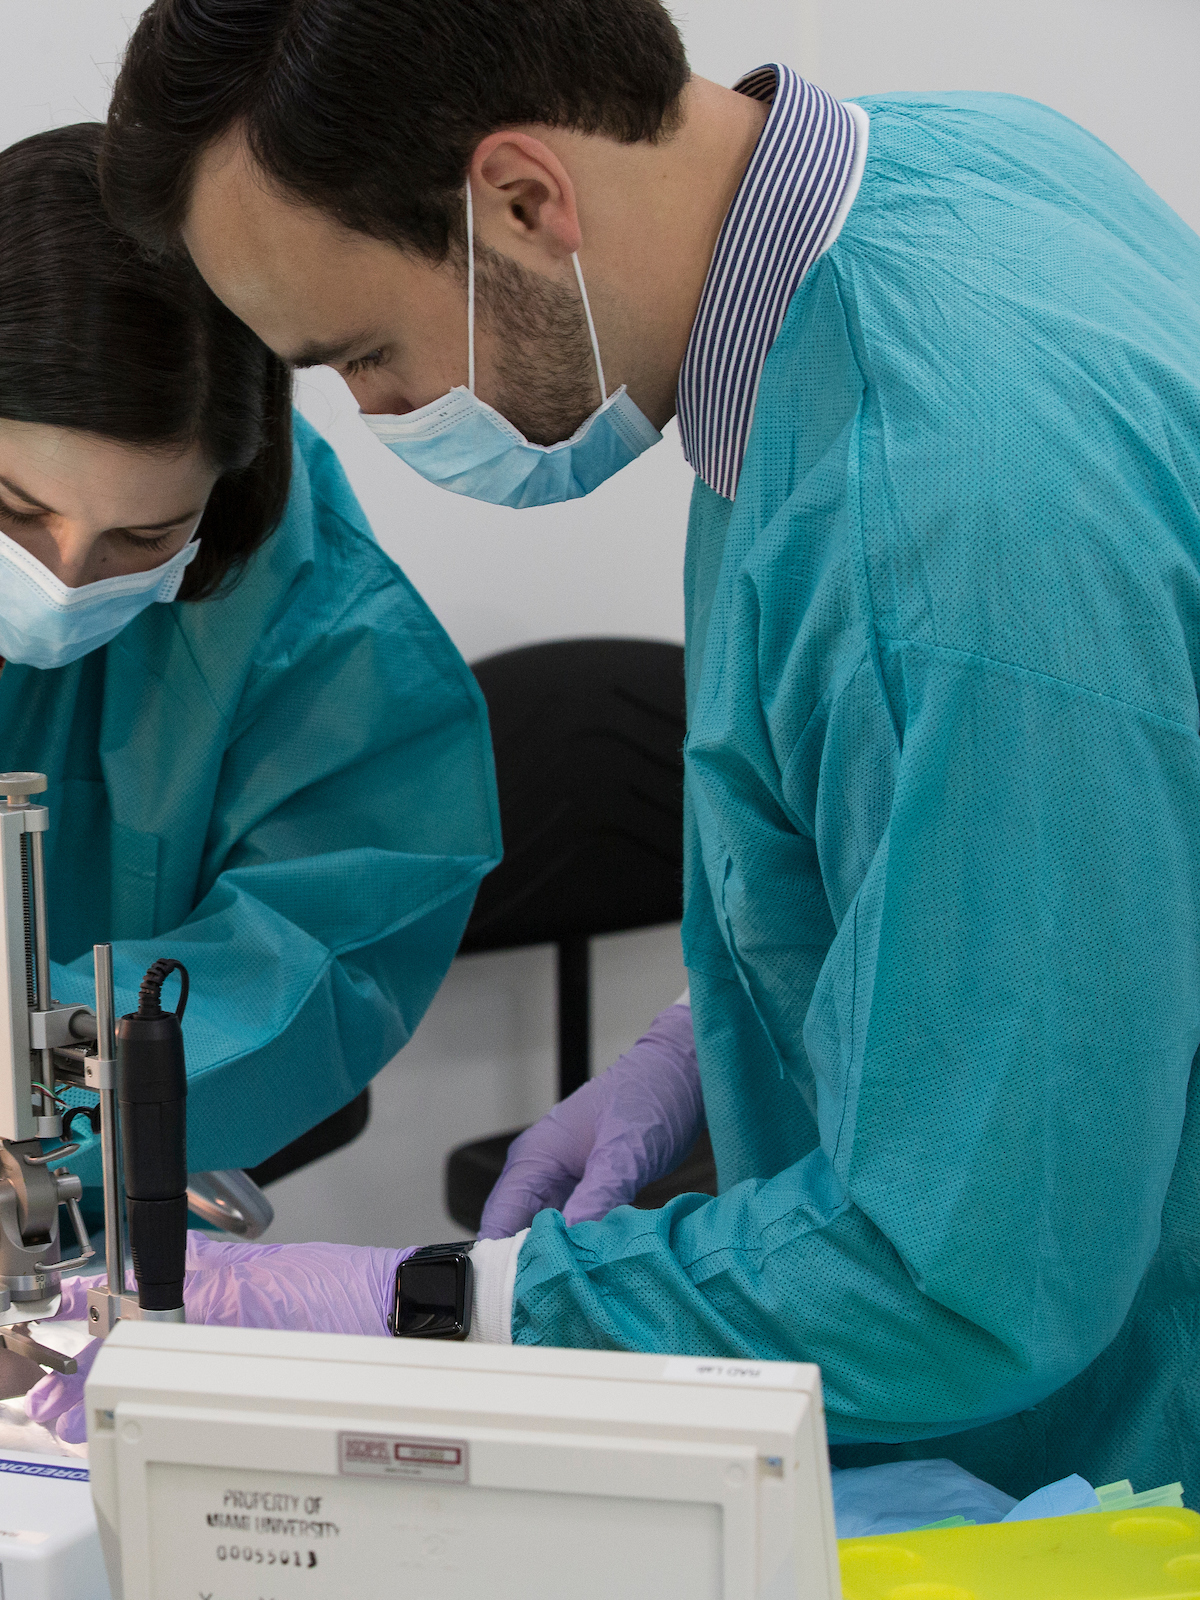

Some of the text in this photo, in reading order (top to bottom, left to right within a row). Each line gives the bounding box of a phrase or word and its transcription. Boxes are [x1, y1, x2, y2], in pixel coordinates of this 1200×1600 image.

[35, 1275, 45, 1283] 90
[223, 1489, 322, 1515] PROPERTY OF
[254, 1517, 341, 1539] UNIVERSITY
